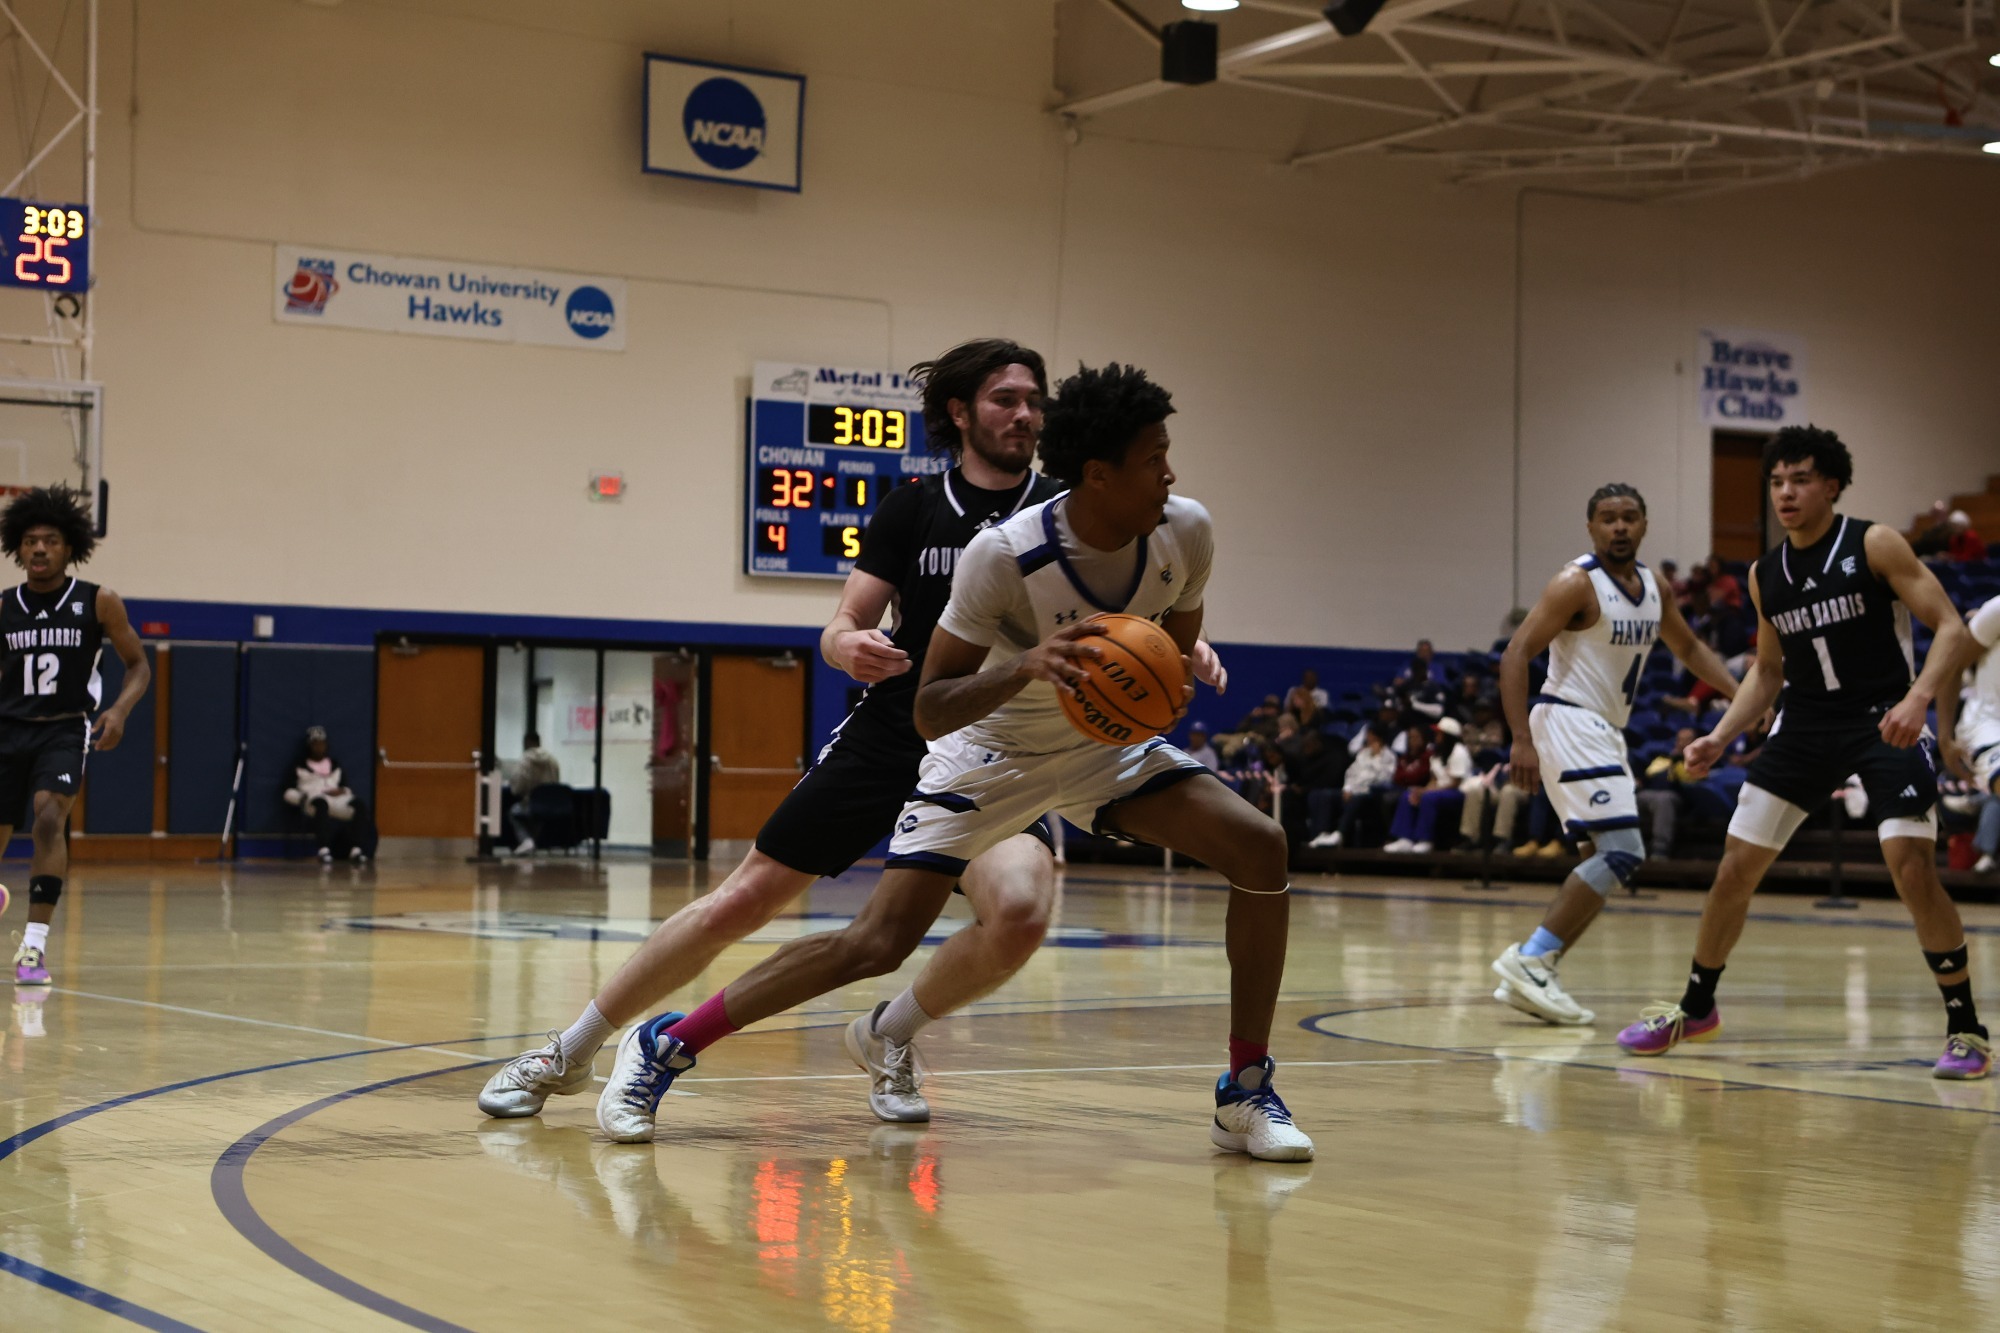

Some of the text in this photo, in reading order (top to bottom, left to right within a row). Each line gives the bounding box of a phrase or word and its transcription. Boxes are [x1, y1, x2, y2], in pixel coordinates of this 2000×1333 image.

[691, 119, 764, 150] NCAA
[24, 205, 83, 239] 3:03
[15, 233, 71, 284] 25
[348, 262, 560, 307] Chowan University
[408, 294, 503, 327] Hawks
[569, 309, 615, 329] NCAA
[1712, 340, 1791, 371] Brave
[815, 366, 882, 388] Metal
[1704, 366, 1798, 397] Hawks
[1717, 395, 1784, 421] Club
[834, 406, 905, 449] 3:03
[758, 444, 826, 467] CHOWAN
[838, 460, 875, 475] PERIOD
[901, 455, 949, 474] GUEST
[772, 469, 814, 508] 32
[857, 479, 866, 506] 1
[755, 508, 790, 523] FOULS
[820, 512, 860, 526] PLAYER
[768, 525, 787, 552] 4
[842, 526, 860, 558] 5
[755, 556, 788, 571] SCORE
[1811, 592, 1867, 628] HARRIS
[5, 627, 82, 651] YOUNG HARRIS
[23, 652, 60, 696] 12
[1621, 652, 1642, 706] 4
[1812, 636, 1842, 692] 1
[1101, 661, 1150, 702] EVO
